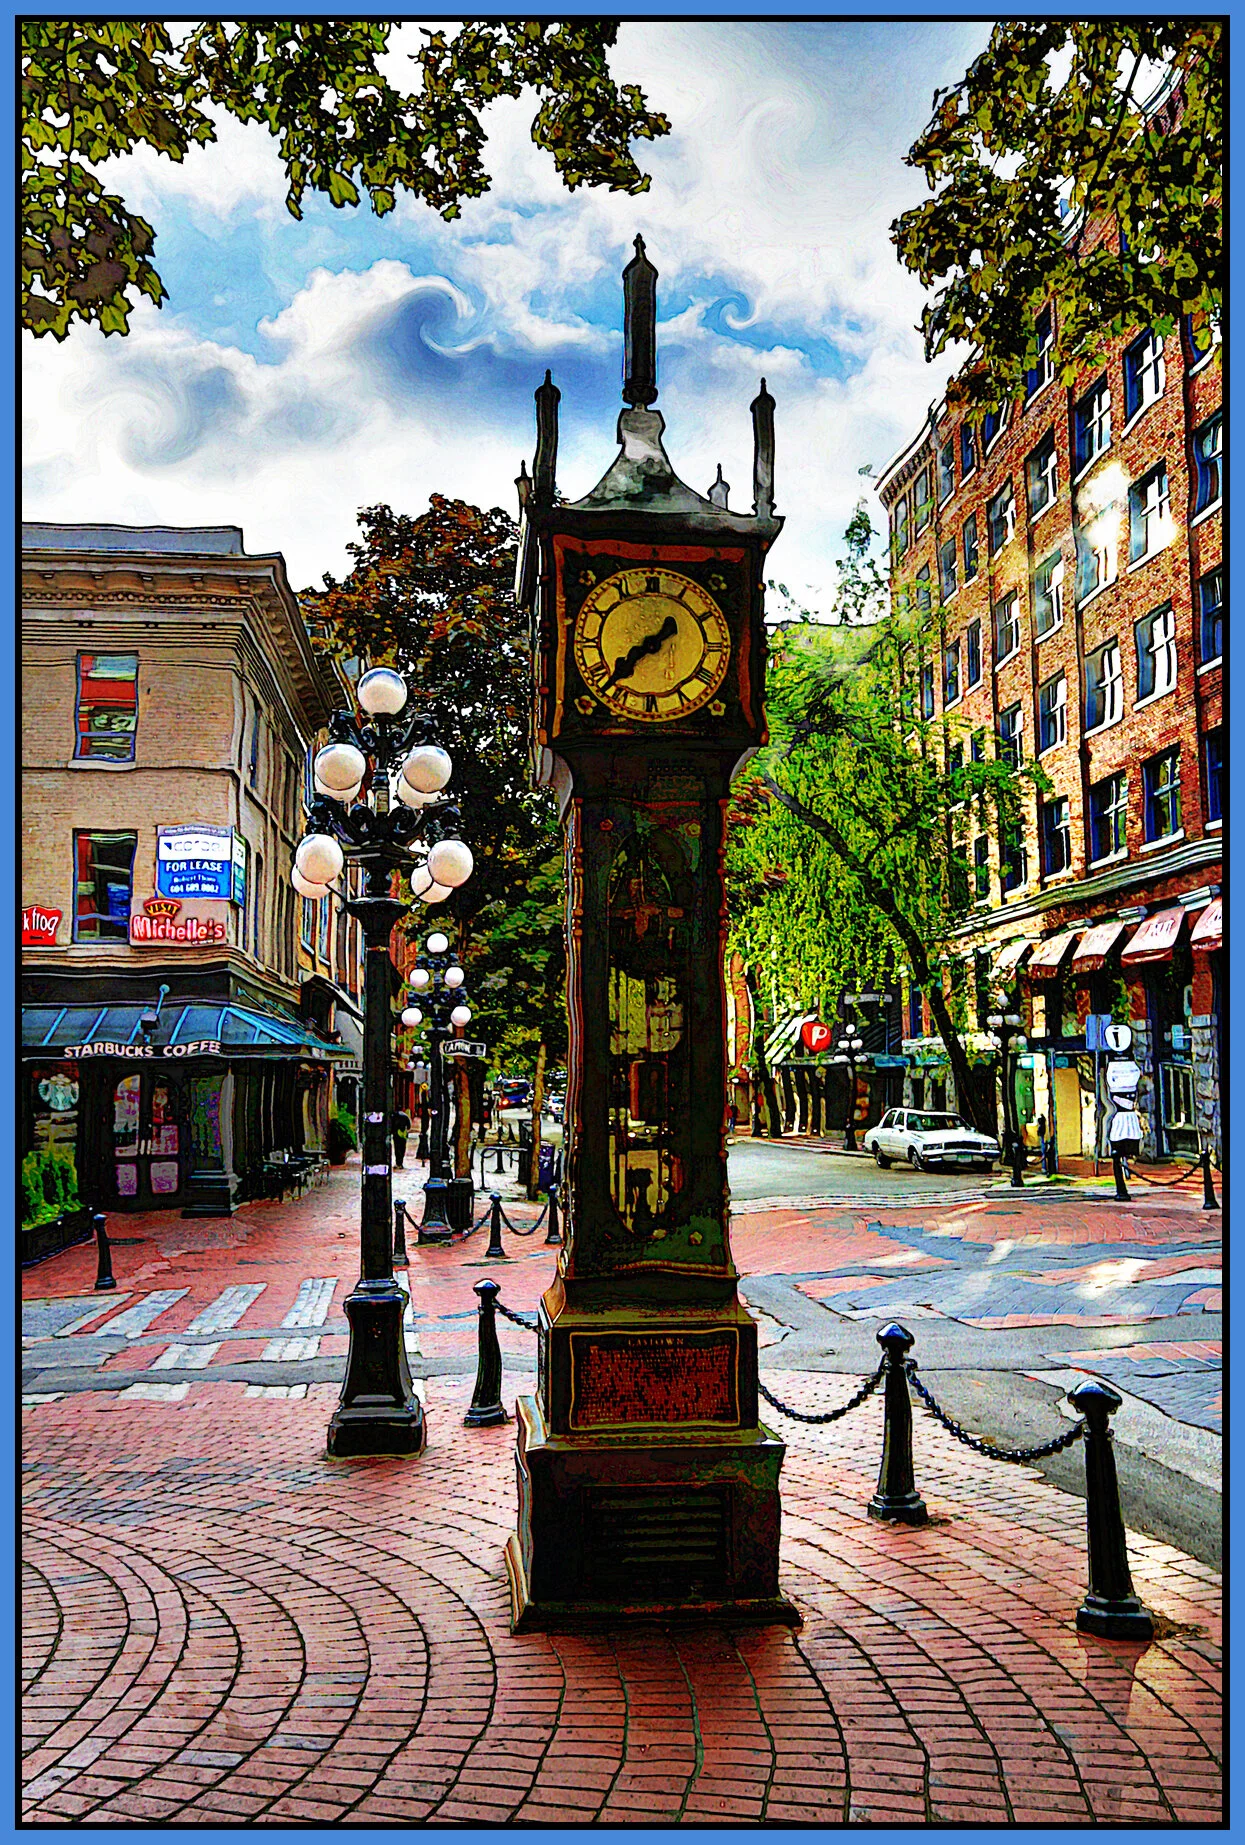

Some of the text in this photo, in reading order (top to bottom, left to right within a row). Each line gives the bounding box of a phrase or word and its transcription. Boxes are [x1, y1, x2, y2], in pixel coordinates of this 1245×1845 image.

[166, 860, 223, 872] FOR LEASE
[147, 903, 178, 915] VISIT
[32, 907, 59, 937] frog
[132, 915, 224, 941] Michelle's
[811, 1025, 828, 1047] P
[64, 1040, 221, 1059] STARBUCKS COFFEE
